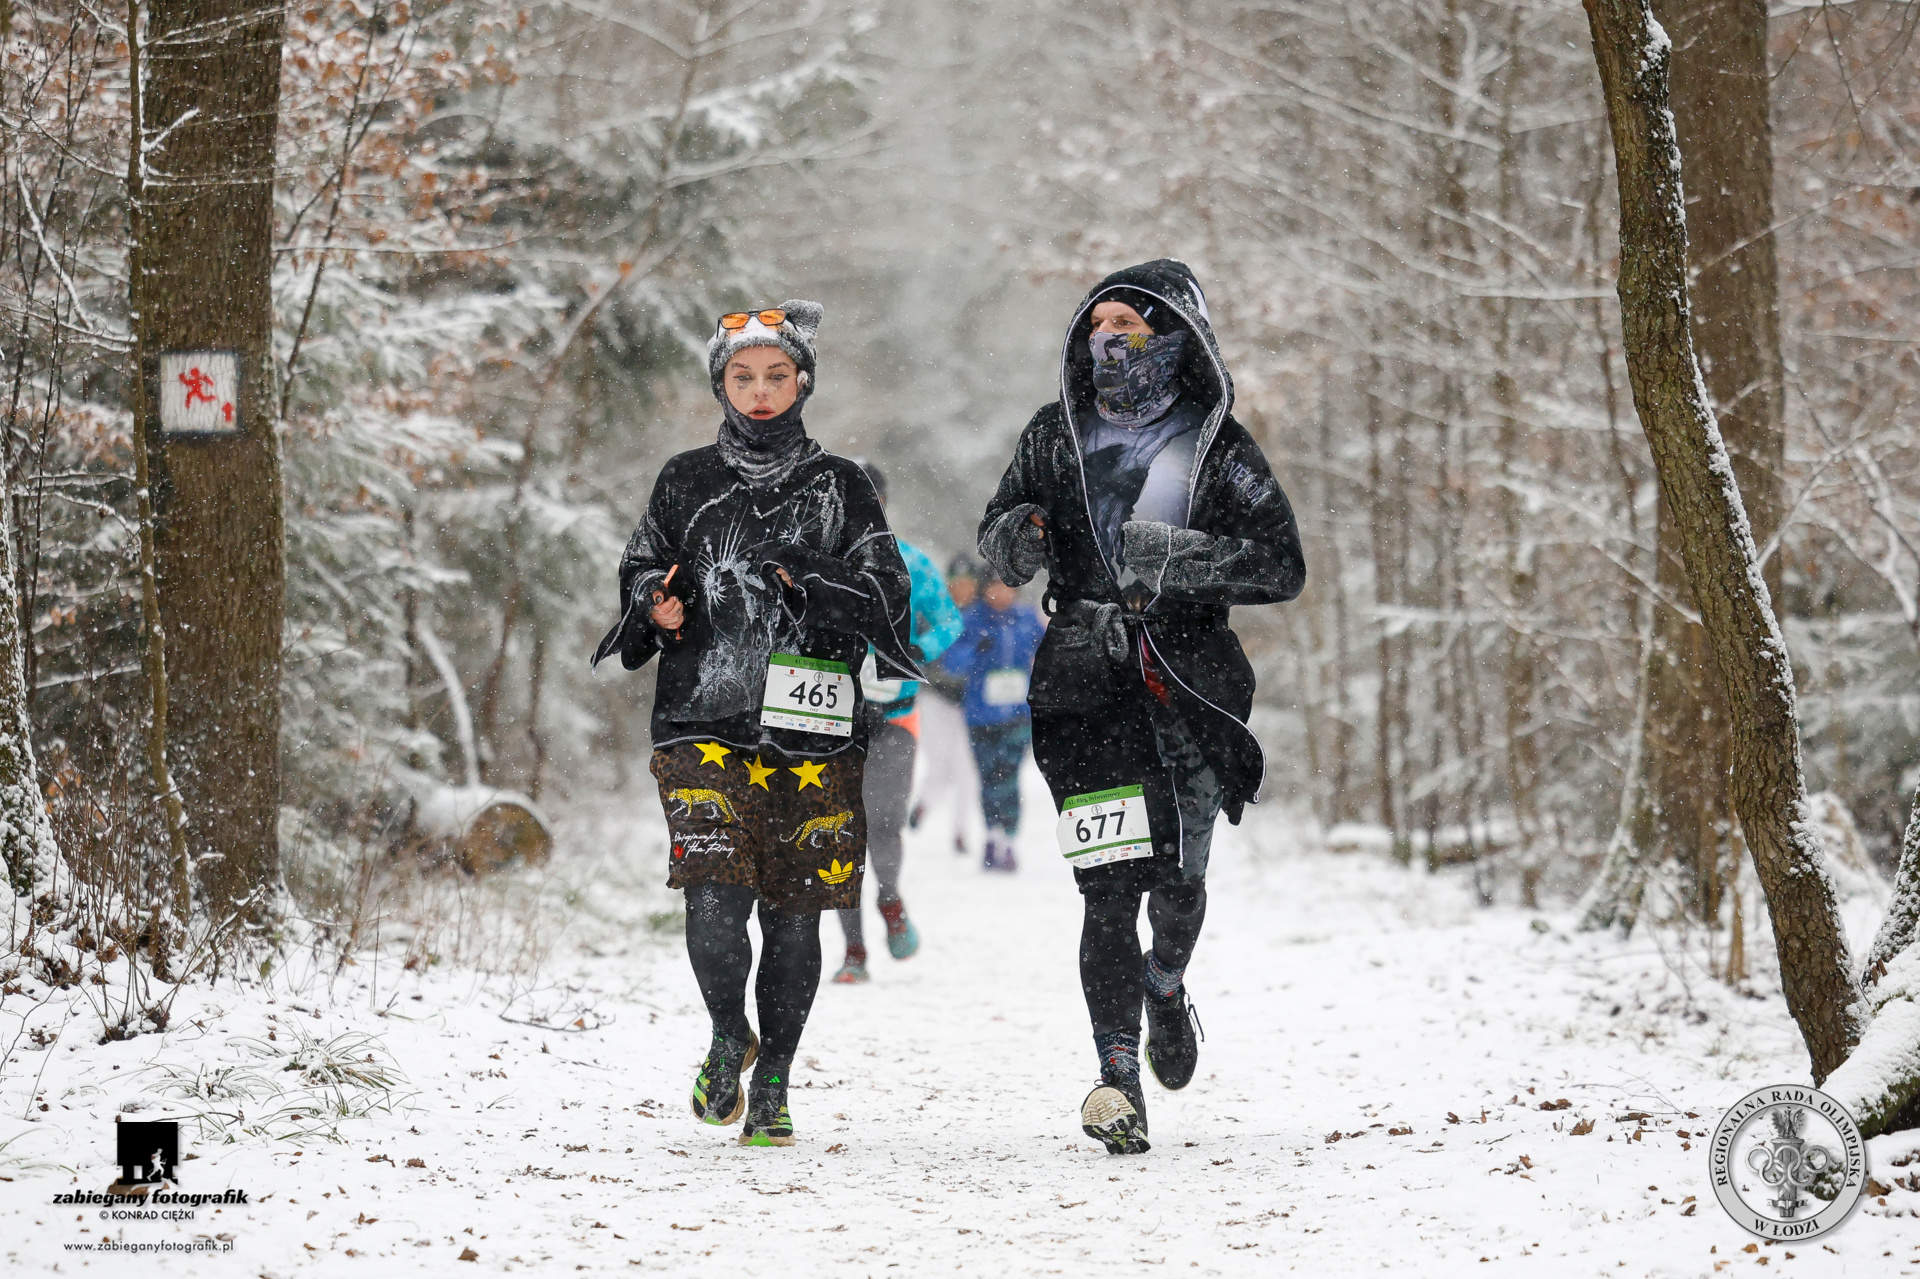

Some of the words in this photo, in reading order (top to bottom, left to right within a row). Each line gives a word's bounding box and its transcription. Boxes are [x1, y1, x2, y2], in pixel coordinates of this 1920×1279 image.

[788, 681, 838, 709] 465
[1075, 811, 1126, 843] 677
[685, 841, 706, 858] the
[705, 841, 735, 859] Ring
